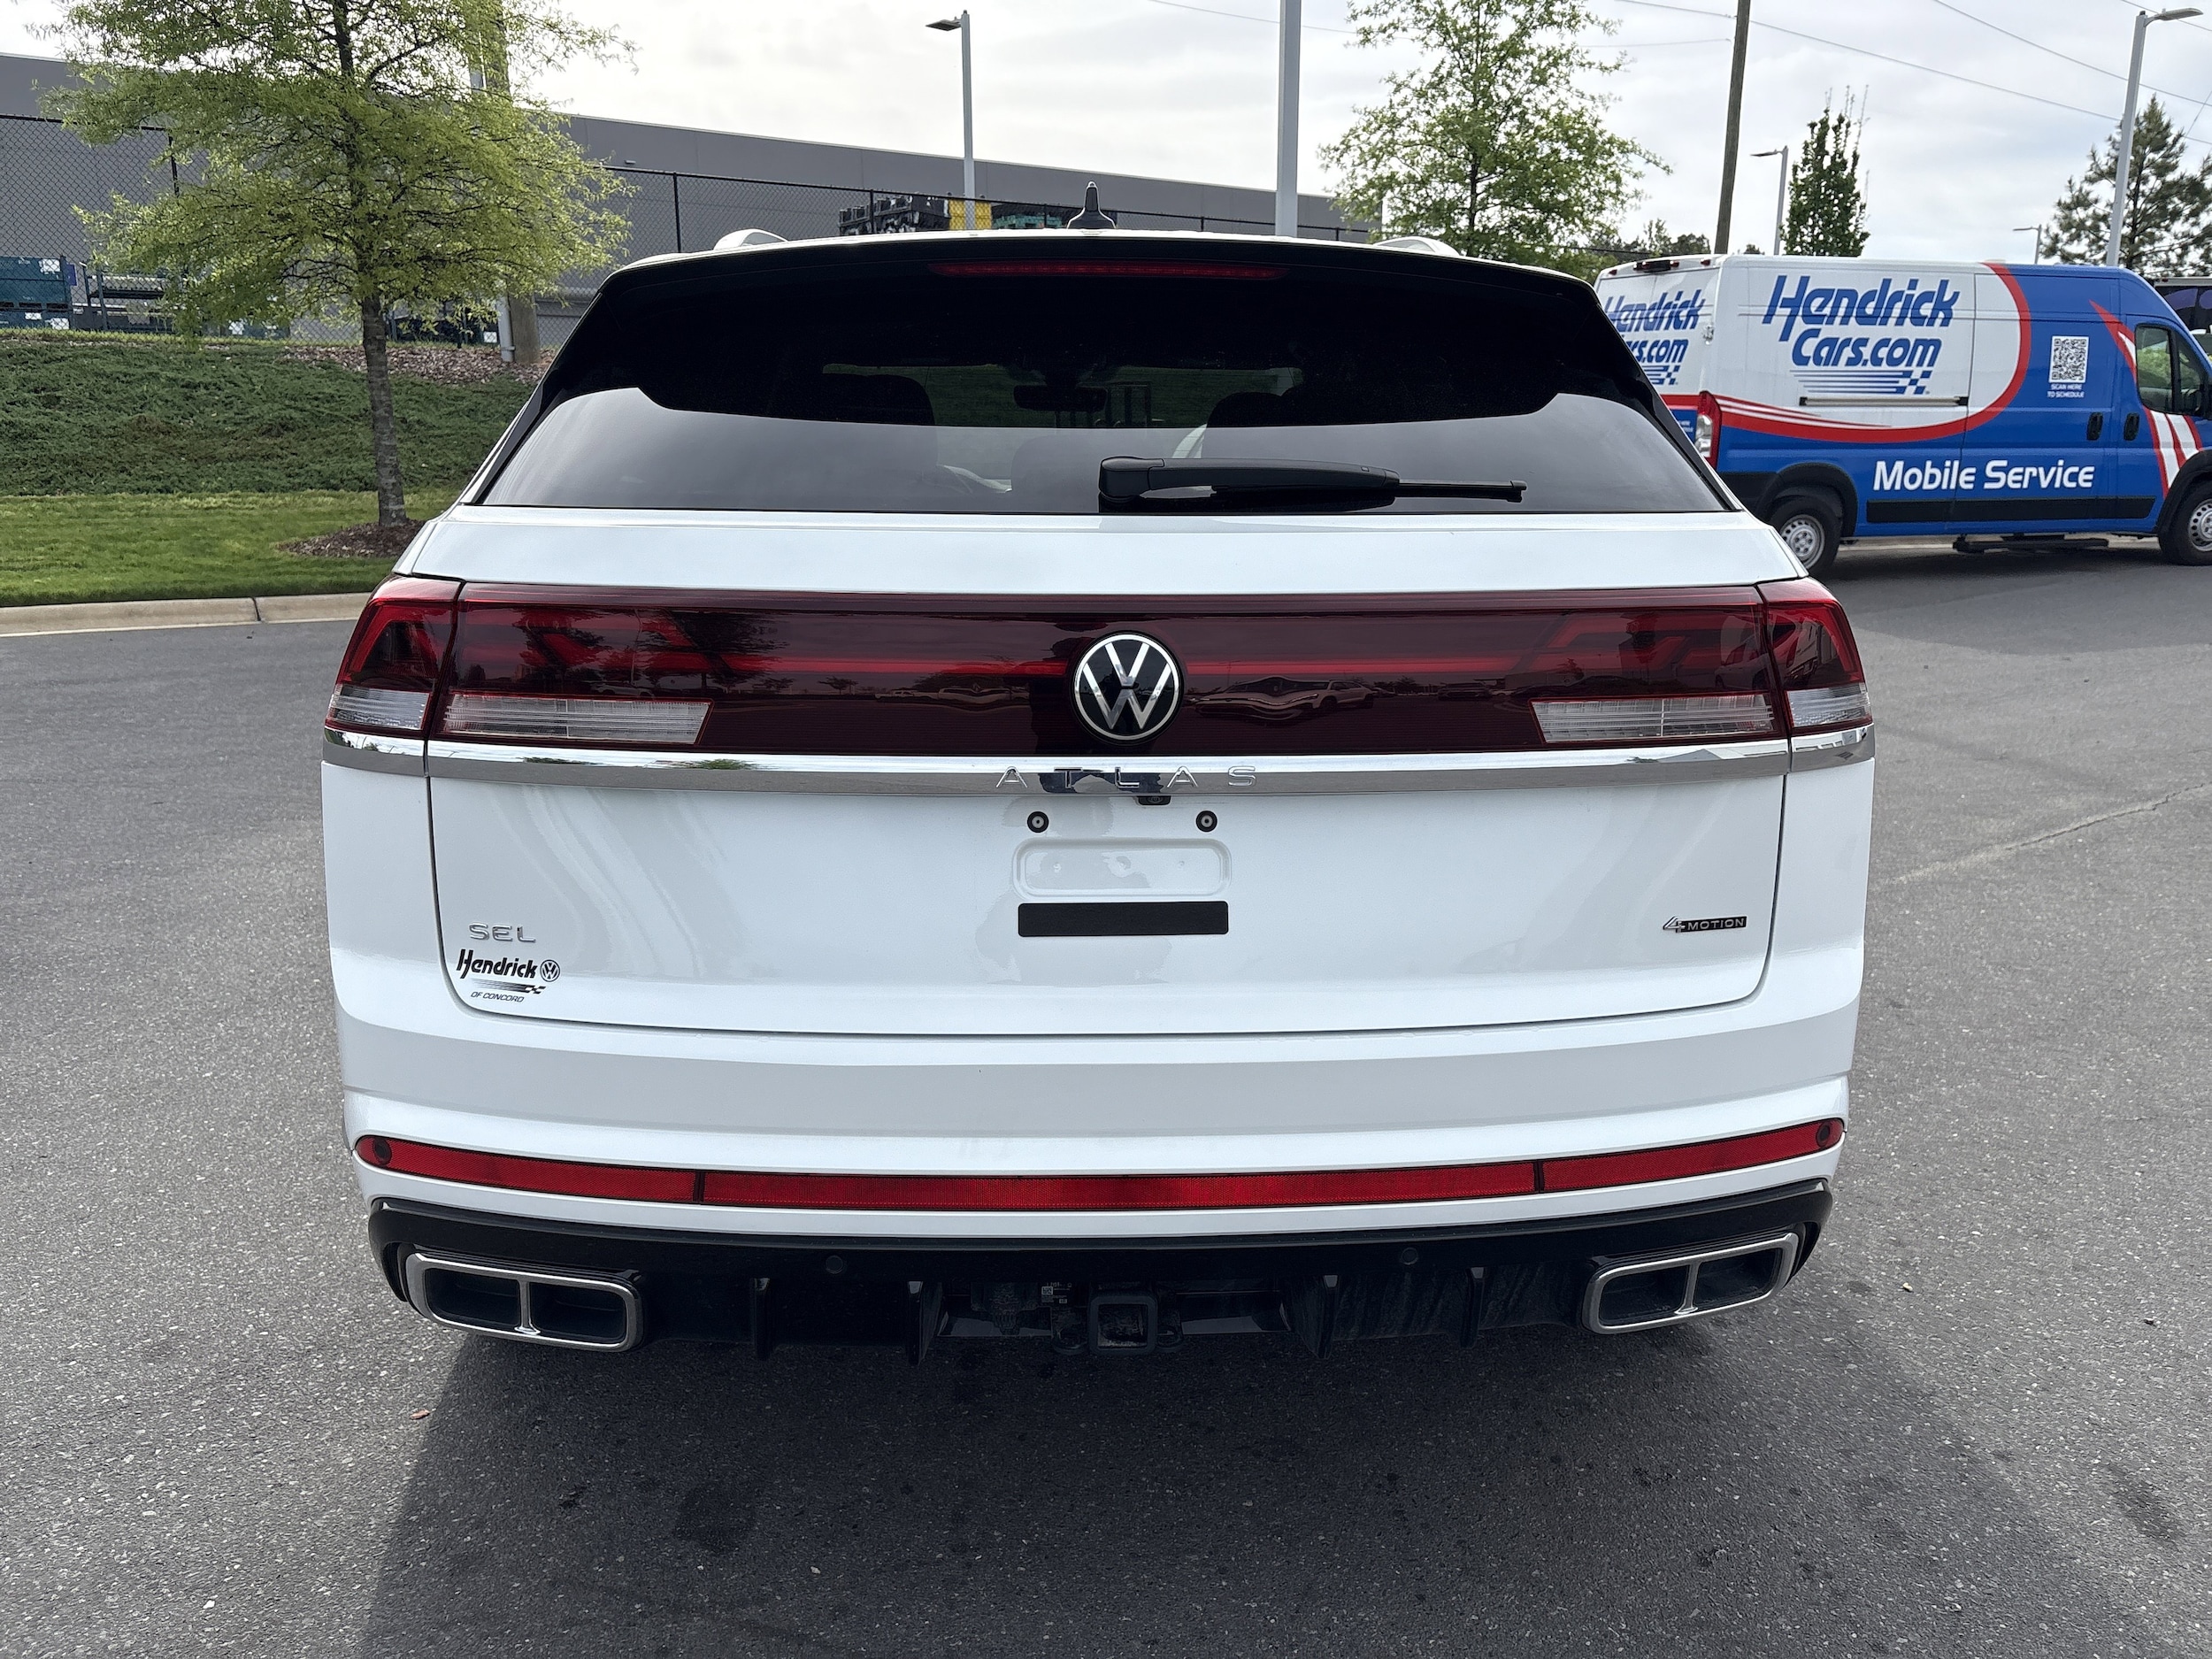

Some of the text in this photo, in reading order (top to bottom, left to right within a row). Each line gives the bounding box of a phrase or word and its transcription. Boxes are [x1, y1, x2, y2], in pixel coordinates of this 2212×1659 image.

[1601, 289, 1702, 333] Hendrick
[1762, 275, 1961, 342] Hendrick
[1625, 339, 1689, 364] rs.com
[1792, 328, 1942, 367] Cars.com
[1873, 459, 2095, 491] Mobile Service
[996, 765, 1256, 789] ATLAS
[469, 922, 536, 943] SEL
[456, 949, 538, 979] Hendrick
[483, 992, 525, 1002] CONCORD
